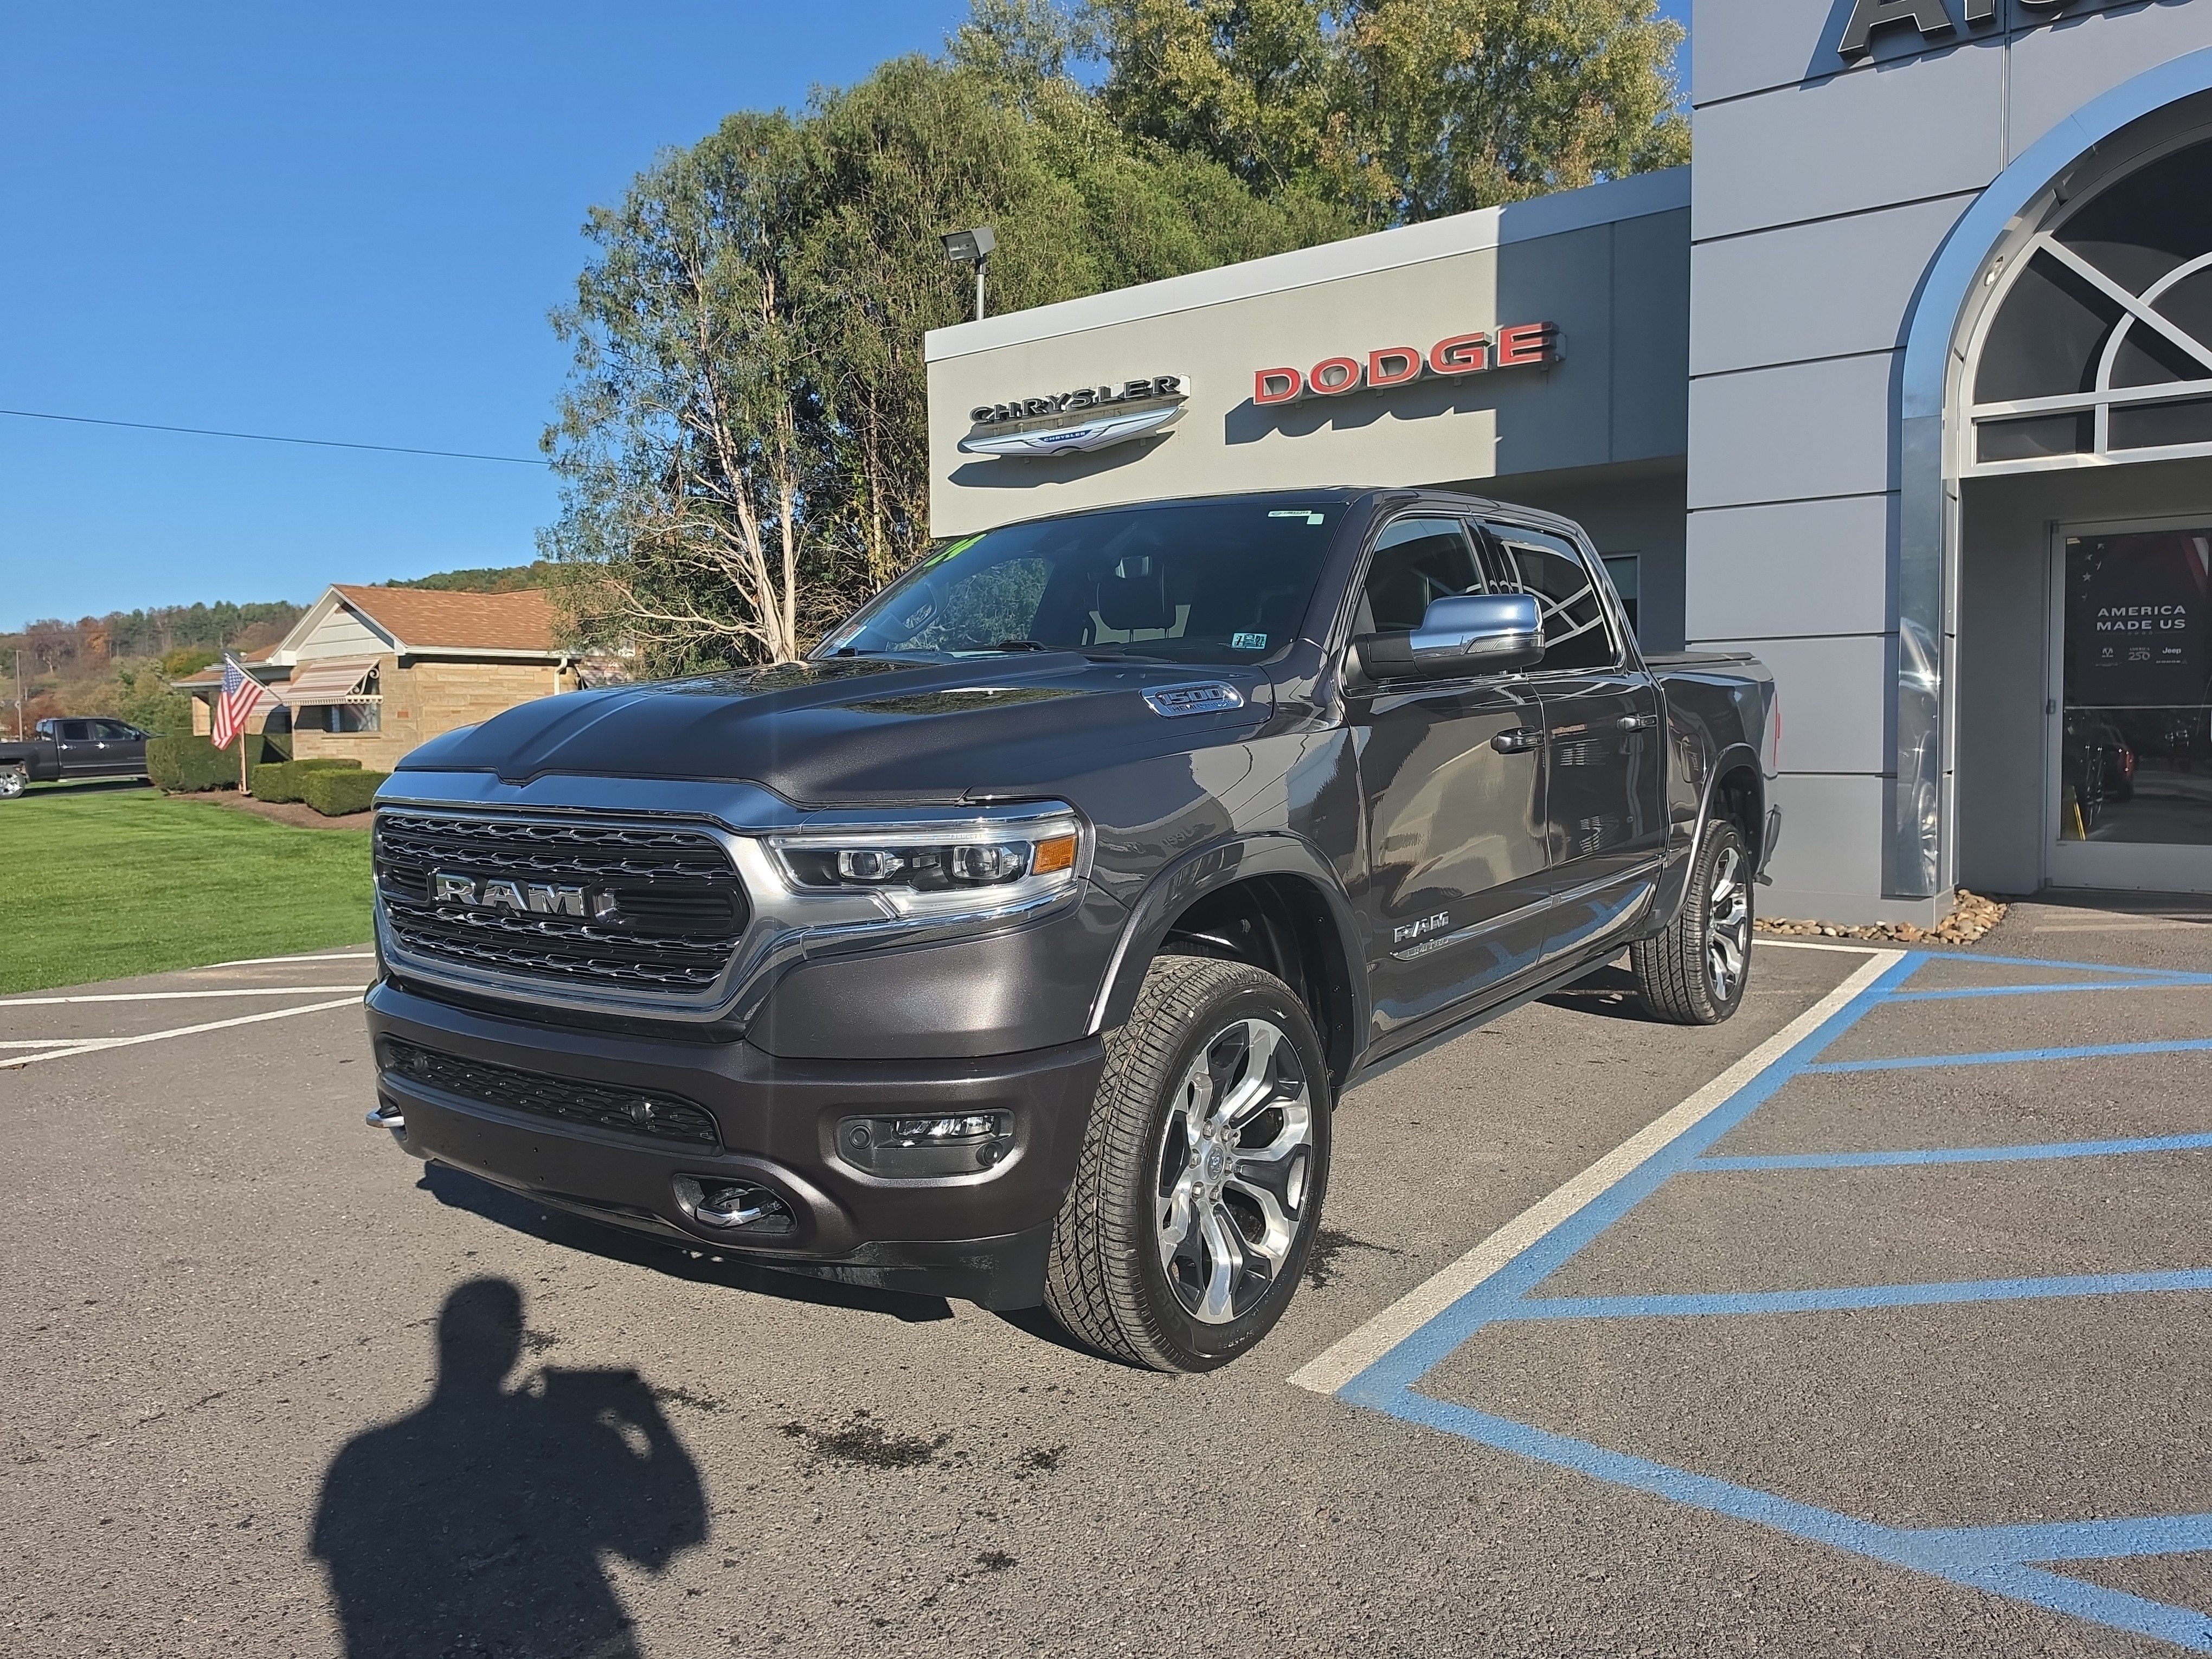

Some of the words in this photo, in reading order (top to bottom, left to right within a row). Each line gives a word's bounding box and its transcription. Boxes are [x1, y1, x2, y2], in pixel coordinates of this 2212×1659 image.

[1253, 321, 1554, 406] DODGE
[969, 375, 1181, 423] CHRYSLER
[1043, 432, 1085, 441] CHRYSLER
[2098, 605, 2185, 617] AMERICA
[2097, 620, 2152, 631] MADE
[2160, 619, 2185, 629] US
[2128, 651, 2150, 661] 250
[2162, 647, 2182, 655] Jeep
[1156, 688, 1223, 705] 1500
[435, 872, 586, 917] RAM
[1393, 911, 1449, 943] RAM
